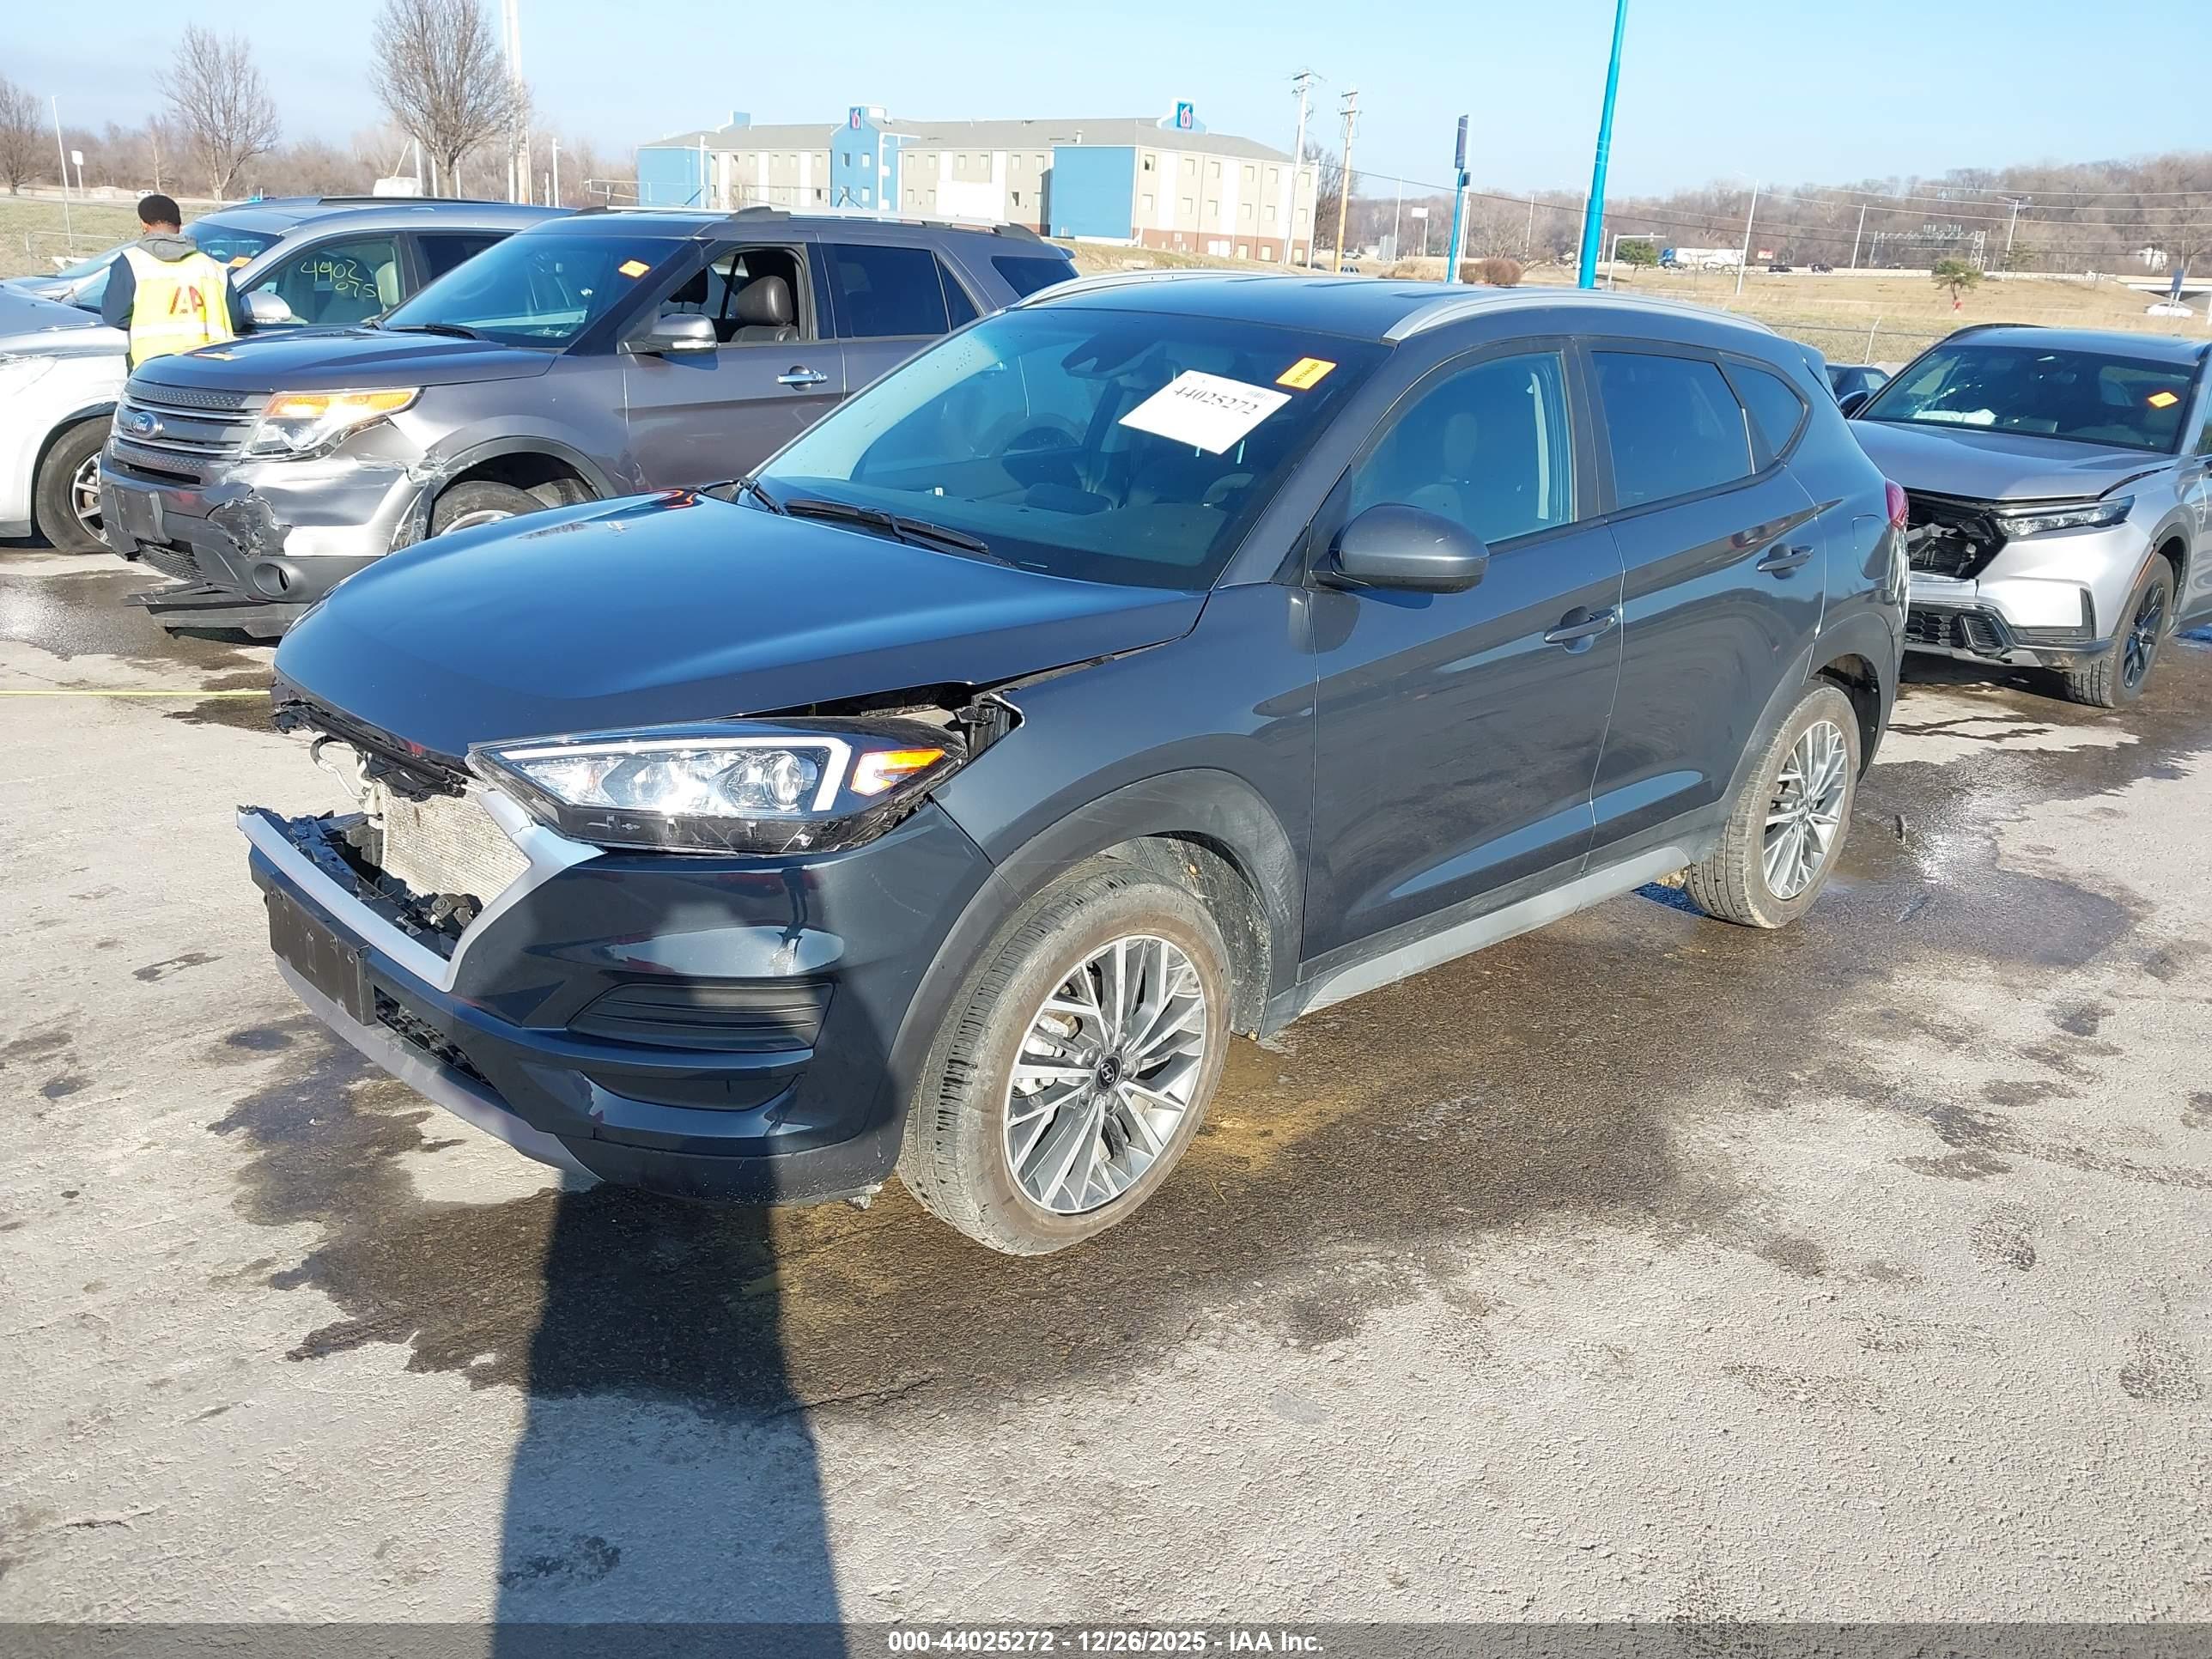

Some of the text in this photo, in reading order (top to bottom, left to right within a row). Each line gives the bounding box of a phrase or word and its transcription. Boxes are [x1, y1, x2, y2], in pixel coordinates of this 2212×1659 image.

[1181, 105, 1192, 129] 6
[301, 258, 363, 283] 4402
[335, 280, 377, 298] 075
[1174, 386, 1258, 415] 44025272
